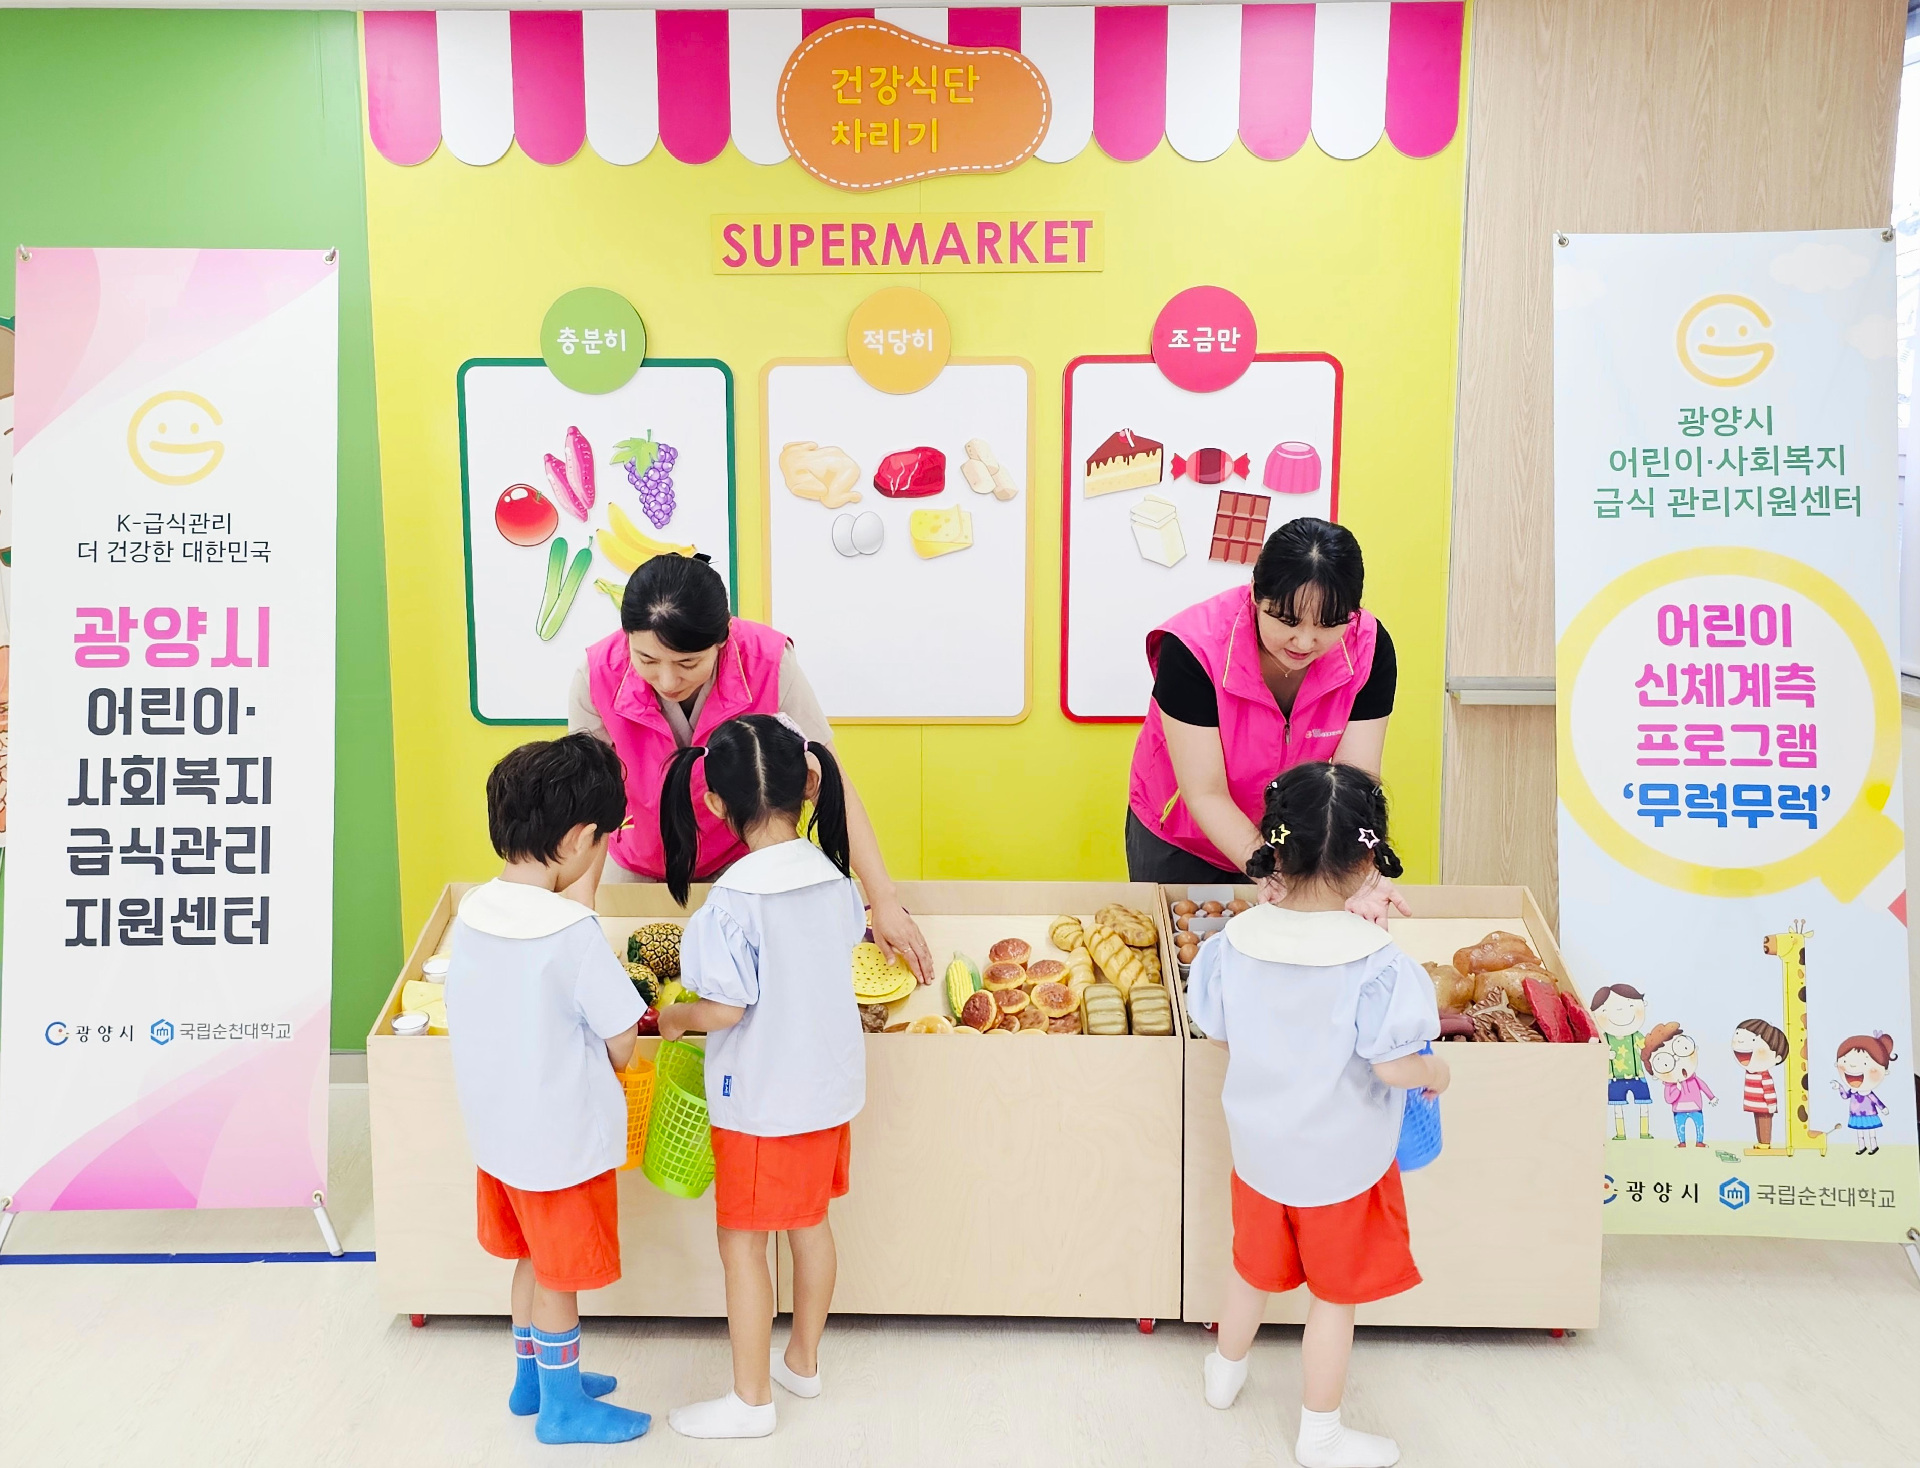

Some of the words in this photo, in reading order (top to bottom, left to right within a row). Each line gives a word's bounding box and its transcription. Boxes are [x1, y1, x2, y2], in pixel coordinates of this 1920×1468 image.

[831, 64, 981, 106] 건강식단
[831, 117, 939, 154] 차리기
[722, 219, 1094, 267] SUPERMARKET
[557, 327, 626, 355] 충분히
[863, 328, 933, 355] 적당히
[1168, 327, 1242, 353] 조금만
[1677, 405, 1774, 438] 광양시
[1609, 444, 1845, 479] 어린이·사회복지
[1593, 486, 1655, 519] 급식
[1667, 485, 1862, 518] 관리지원센터
[117, 512, 232, 535] K-급식관리
[78, 541, 98, 564] 더
[107, 541, 174, 564] 건강한
[183, 541, 272, 564] 대한민국
[74, 606, 270, 669] 광양시
[1657, 603, 1793, 648] 어린이
[1635, 662, 1817, 709] 신체계측
[1636, 723, 1818, 769] 프로그램
[67, 755, 273, 807] 사회복지
[66, 825, 271, 876] 급식관리
[65, 896, 270, 947] 지원센터
[75, 1024, 134, 1043] 광양시
[179, 1022, 291, 1040] 국립순천대학교
[1625, 1181, 1699, 1204] 광양시
[1756, 1183, 1897, 1209] 국립순천대학교
